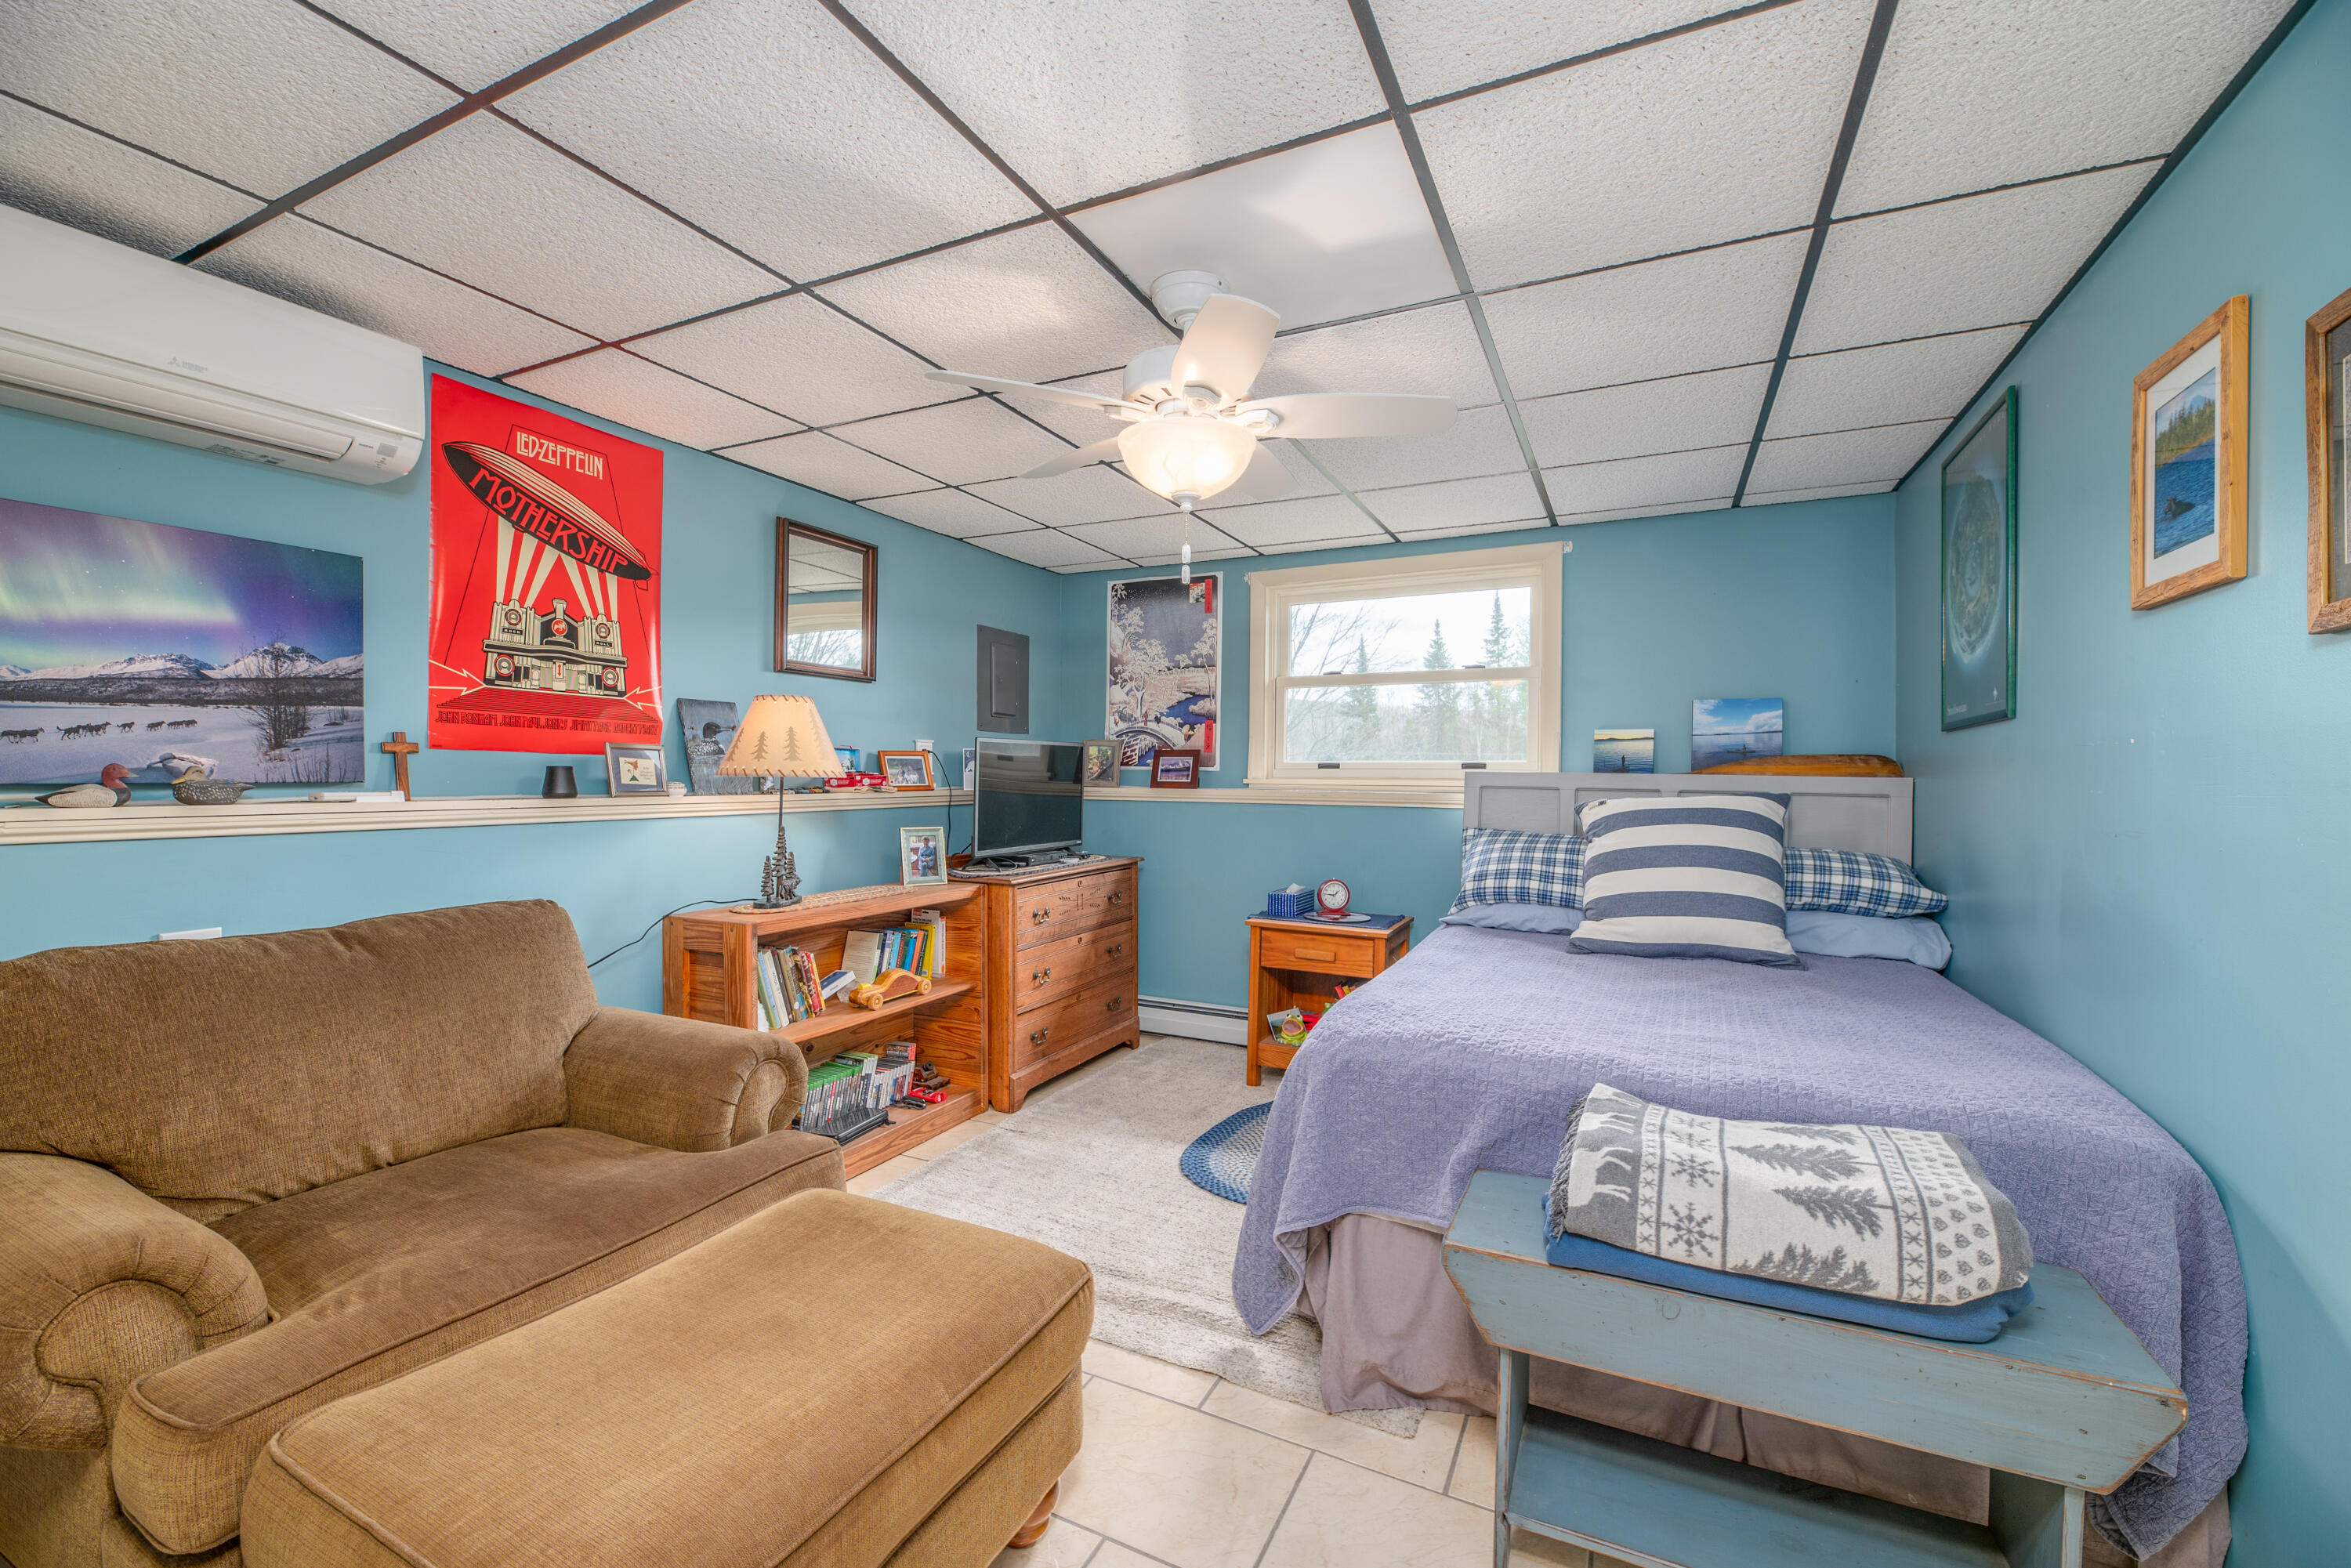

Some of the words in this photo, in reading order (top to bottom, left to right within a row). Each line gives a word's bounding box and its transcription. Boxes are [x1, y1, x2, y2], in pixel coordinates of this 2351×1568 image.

[469, 467, 628, 574] MOTHERSHIP
[435, 710, 459, 724] JOHN
[499, 715, 522, 728] JOHN
